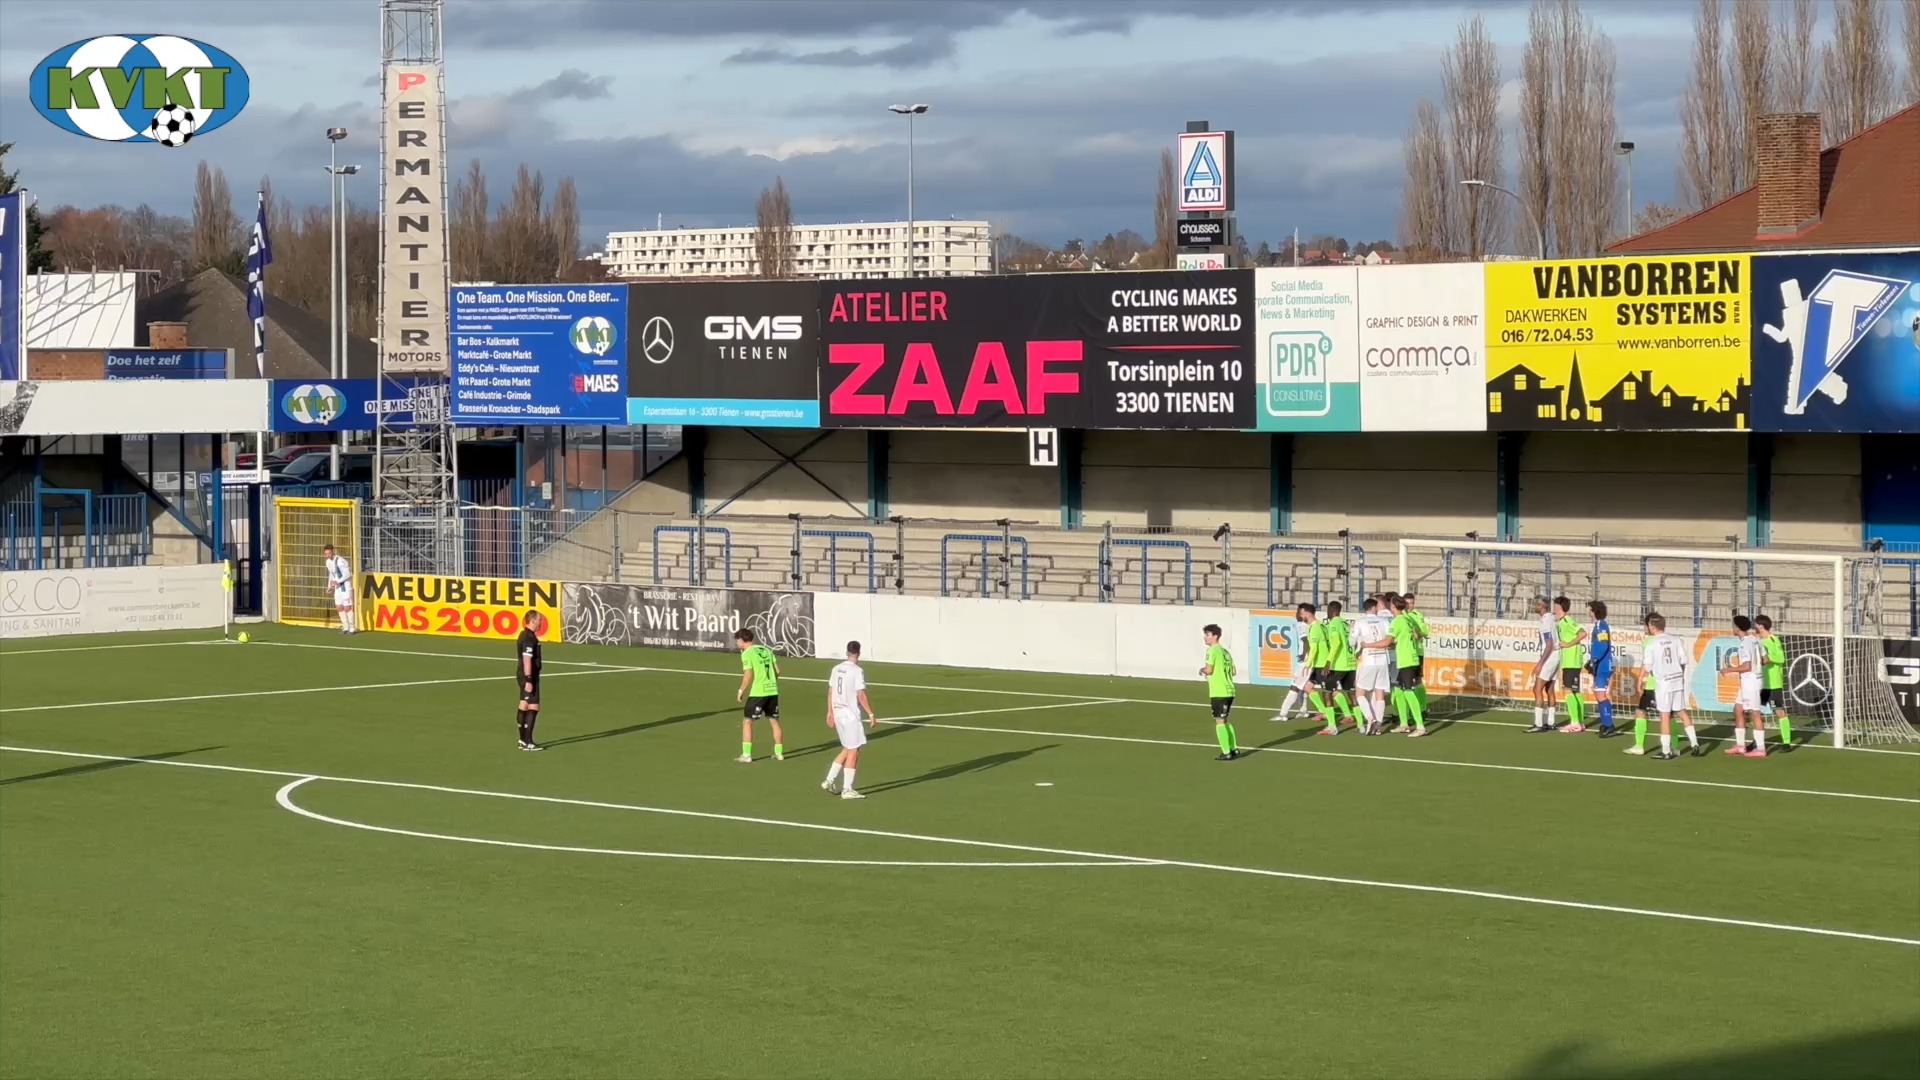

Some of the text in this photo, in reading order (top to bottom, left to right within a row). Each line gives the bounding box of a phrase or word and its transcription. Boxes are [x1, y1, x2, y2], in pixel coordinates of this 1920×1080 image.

[1187, 189, 1219, 202] ALDI
[395, 73, 431, 347] PERMANTIER
[1270, 280, 1323, 292] Social Media
[1533, 260, 1740, 299] VANBORREN
[457, 291, 475, 304] One
[477, 291, 504, 304] Team.
[506, 291, 525, 303] One
[527, 290, 565, 303] Mission.
[567, 290, 587, 303] One
[1111, 287, 1237, 307] CYCLING MAKES
[1285, 293, 1353, 306] Communication,
[828, 291, 947, 322] ATELIER
[1260, 307, 1335, 320] News & Marketing
[1617, 301, 1726, 326] SYSTEMS
[1366, 314, 1478, 329] GRAPHIC DESIGN & PRINT
[1505, 308, 1587, 323] DAKWERKEN
[704, 315, 802, 340] GMS
[1107, 314, 1242, 333] A BETTER WORLD
[457, 337, 468, 346] Bar
[469, 337, 482, 346] Bos
[1501, 327, 1594, 343] 016/72.04.53
[1617, 335, 1741, 350] www.vanborren.be
[107, 354, 181, 366] Doe het zelf
[388, 352, 441, 362] MOTORS
[493, 350, 511, 359] Grote
[512, 350, 532, 359] Markt
[719, 346, 787, 359] TIENEN
[1276, 343, 1317, 377] PDR
[479, 364, 494, 373] Café
[499, 364, 540, 373] Nieuwstraat
[1107, 359, 1242, 387] Torsinplein 10
[458, 377, 469, 386] Wit
[469, 377, 488, 386] Paard
[492, 378, 511, 386] Grote
[512, 378, 531, 386] Markt
[584, 374, 619, 392] MAES
[828, 340, 1083, 414] ZAAF
[458, 390, 473, 399] Café
[473, 390, 501, 399] Industrie
[506, 391, 532, 400] Grimde
[1116, 392, 1234, 413] 3300 TIENEN
[1273, 389, 1323, 402] CONSULTING
[287, 396, 341, 412] KVKT
[390, 399, 437, 411] MISSON.
[458, 403, 488, 413] Brasserie
[526, 404, 561, 415] Stadspark
[719, 407, 739, 417] Tienen
[1034, 431, 1054, 462] H
[2, 576, 81, 613] & CO
[362, 574, 558, 608] MEUBELEN
[23, 619, 30, 630] &
[33, 617, 81, 630] SANITAIR
[375, 604, 430, 631] MS
[644, 605, 680, 631] Wit
[685, 607, 740, 633] Paard
[1259, 625, 1292, 649] ICS
[1439, 638, 1504, 650] LANDBOUW
[1513, 641, 1544, 652] GARA
[837, 676, 843, 695] 8
